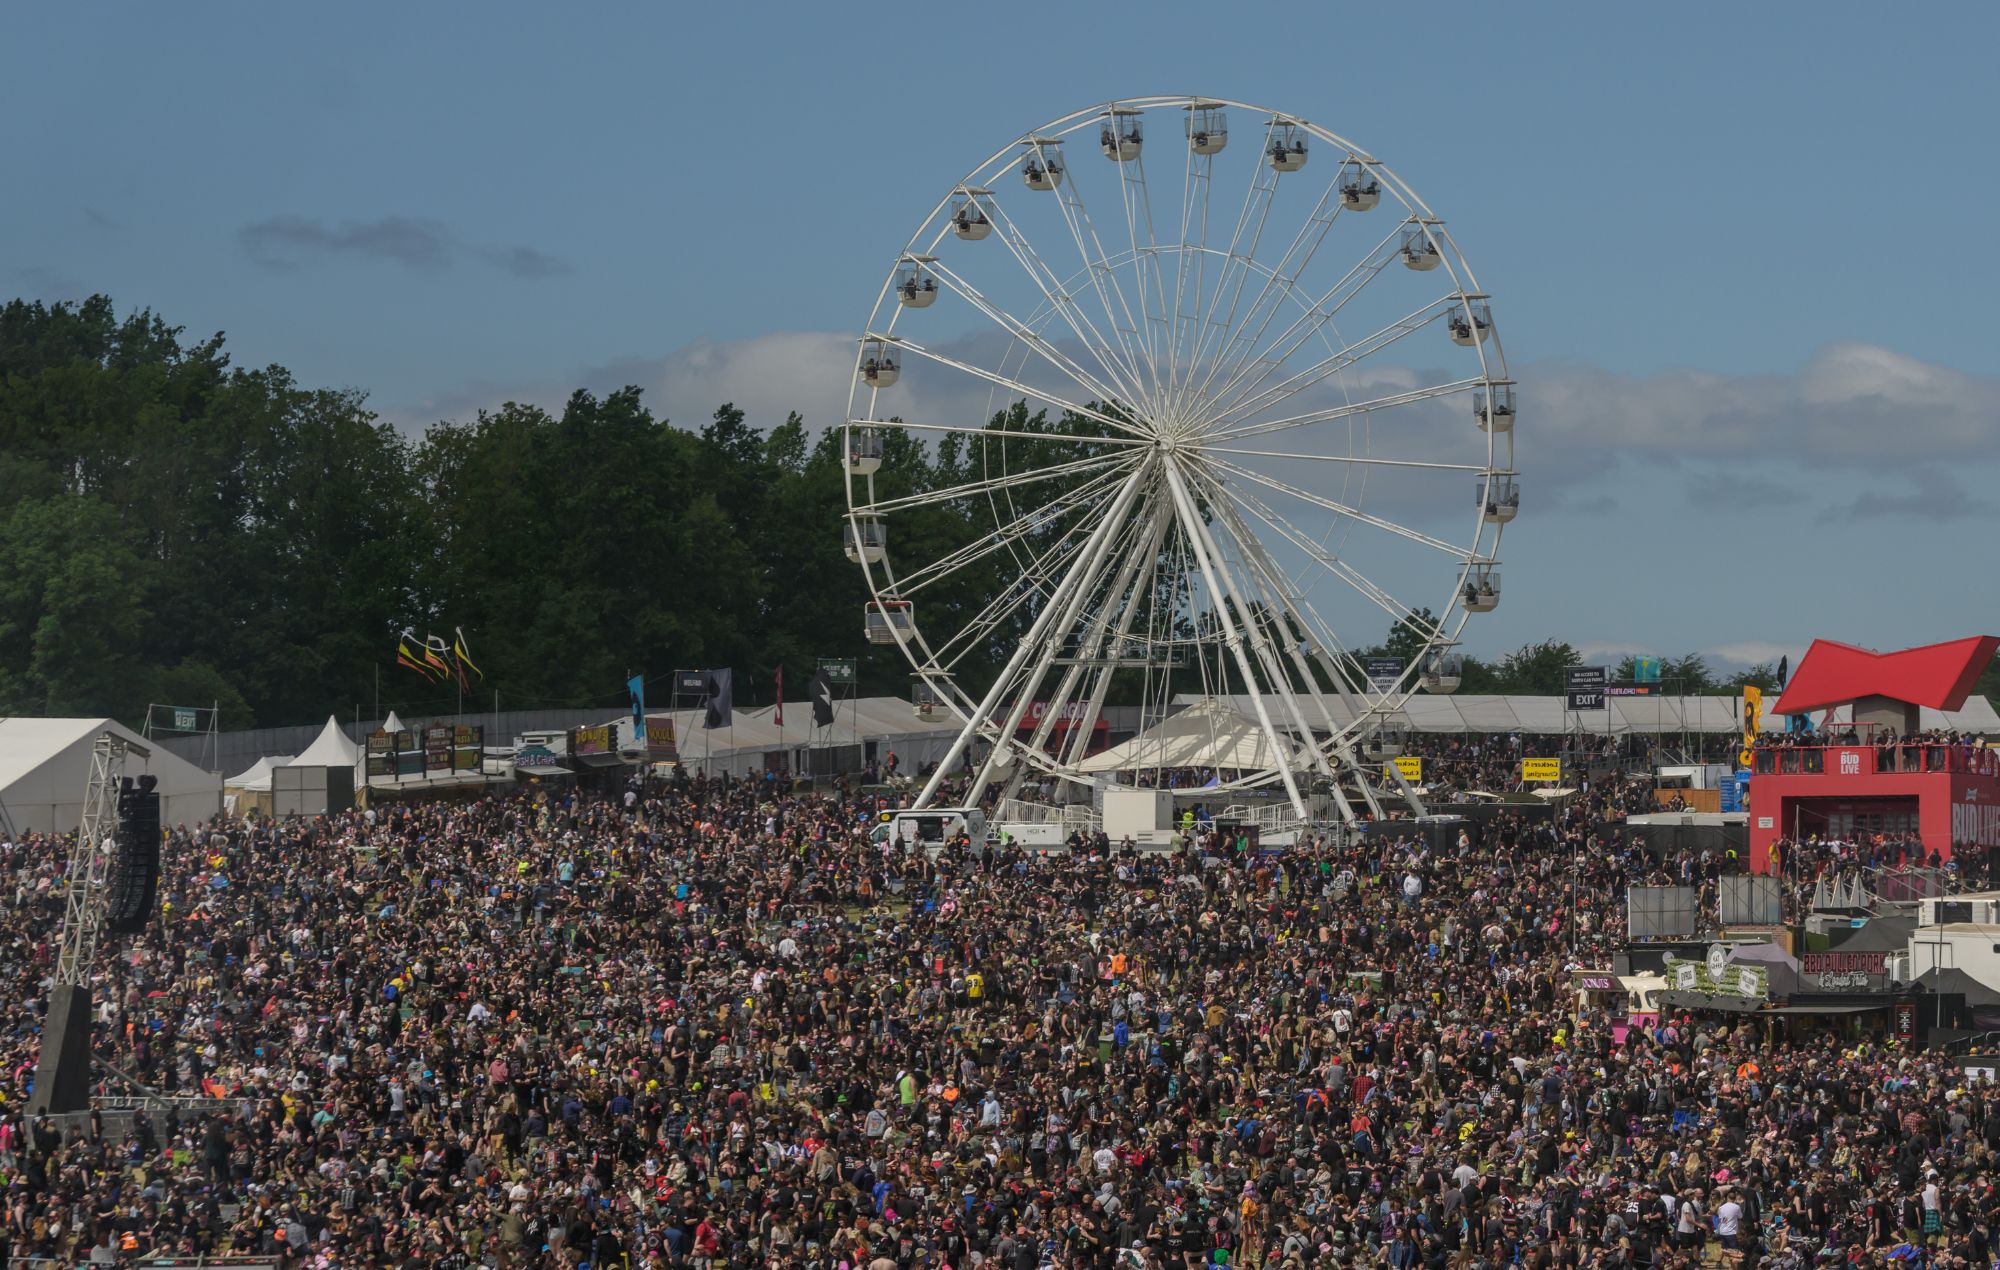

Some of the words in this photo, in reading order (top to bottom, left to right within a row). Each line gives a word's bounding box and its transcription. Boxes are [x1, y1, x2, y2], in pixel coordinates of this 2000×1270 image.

[1576, 694, 1597, 705] EXIT
[1840, 755, 1860, 765] BUD
[1840, 765, 1860, 775] LIVE
[1952, 802, 1978, 845] BUD
[1860, 953, 1886, 973] PORK
[1581, 977, 1609, 989] DONUTS
[1626, 1201, 1640, 1213] 25
